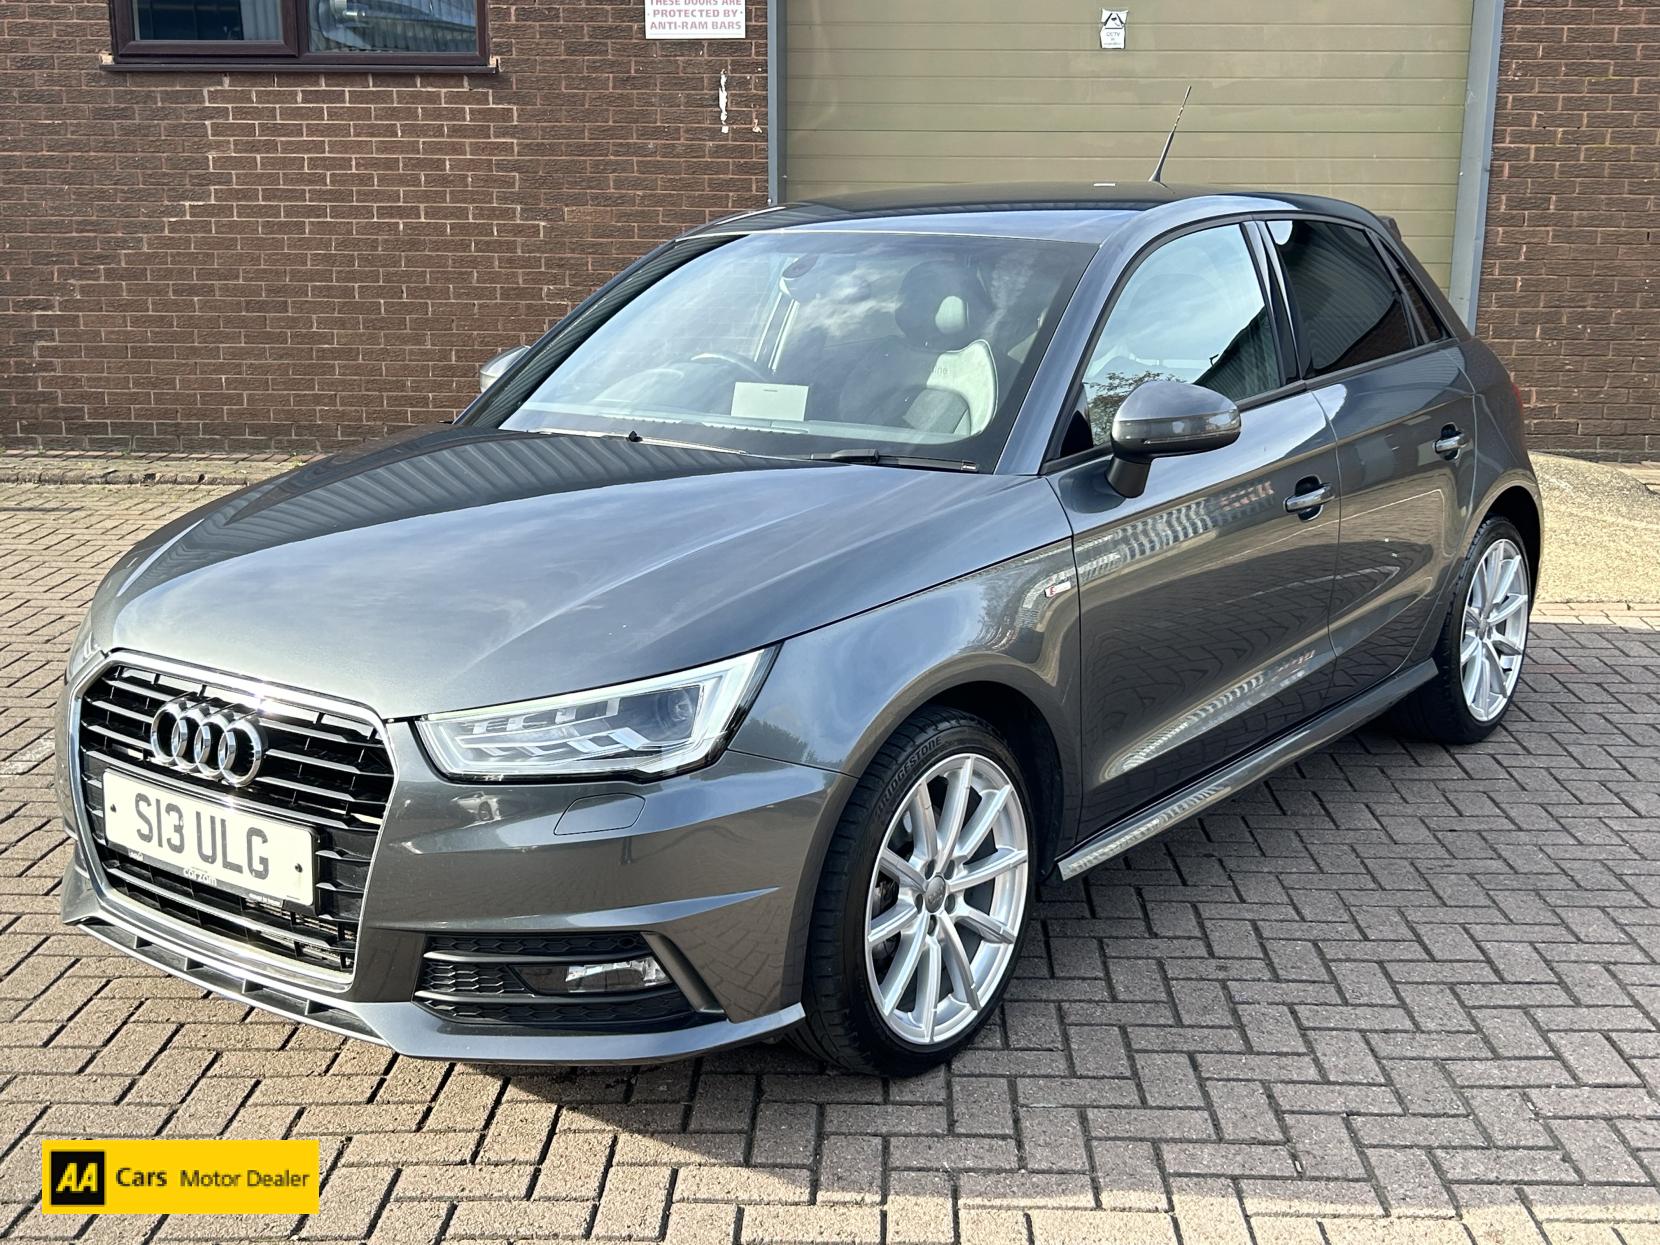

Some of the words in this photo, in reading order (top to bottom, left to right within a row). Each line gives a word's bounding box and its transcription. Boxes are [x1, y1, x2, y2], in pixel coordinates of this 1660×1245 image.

[650, 21, 708, 30] ANTI-RAM
[711, 21, 742, 30] BARS
[653, 9, 720, 18] PROTECTED
[723, 9, 738, 18] BY
[874, 736, 944, 817] BRIDGESTONE
[134, 792, 185, 854] S13
[195, 810, 269, 880] ULG
